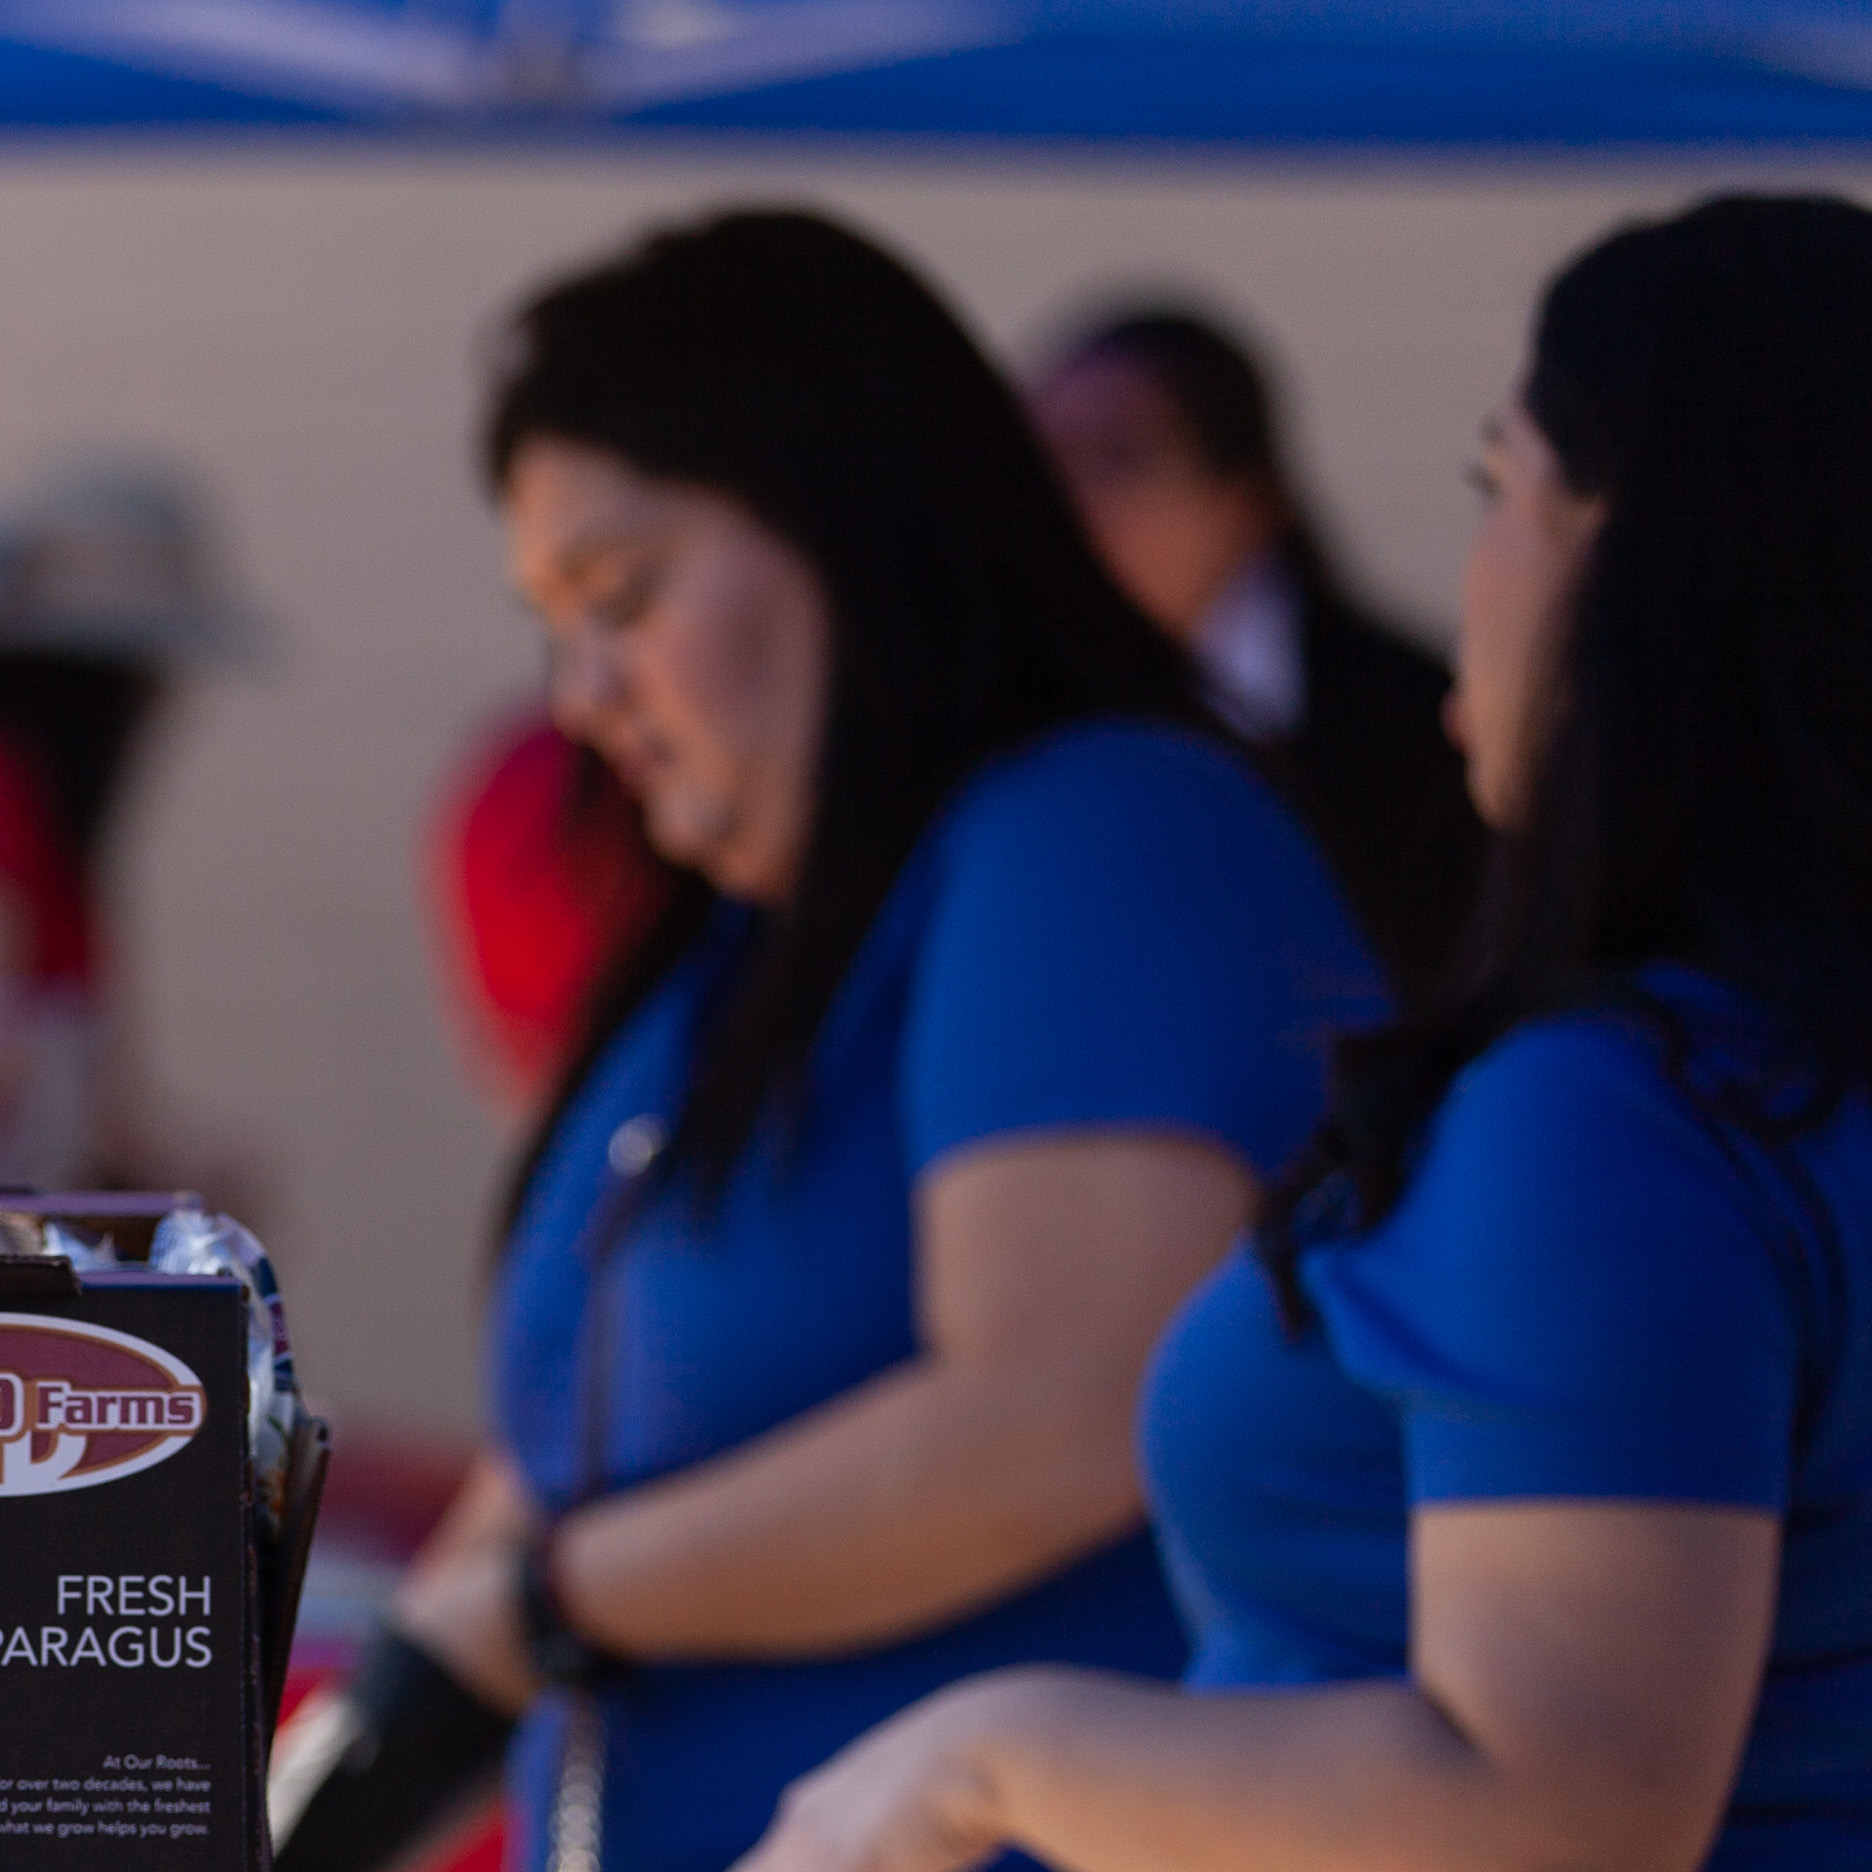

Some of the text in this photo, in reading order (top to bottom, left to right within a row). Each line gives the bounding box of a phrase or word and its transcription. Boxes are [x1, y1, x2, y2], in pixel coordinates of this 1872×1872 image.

[35, 1381, 197, 1428] Farms
[57, 1575, 212, 1616] FRESH
[103, 1754, 121, 1769] At
[123, 1754, 153, 1770] Our
[16, 1779, 49, 1791] over
[52, 1777, 81, 1791] two
[151, 1779, 173, 1791] we
[175, 1776, 211, 1791] have
[10, 1801, 42, 1816] your
[46, 1797, 90, 1816] family
[92, 1798, 124, 1813] with
[126, 1798, 151, 1813] the
[154, 1797, 211, 1814] freshest
[32, 1823, 54, 1834] we
[57, 1823, 95, 1838] grow
[97, 1820, 137, 1837] helps
[139, 1823, 167, 1839] you
